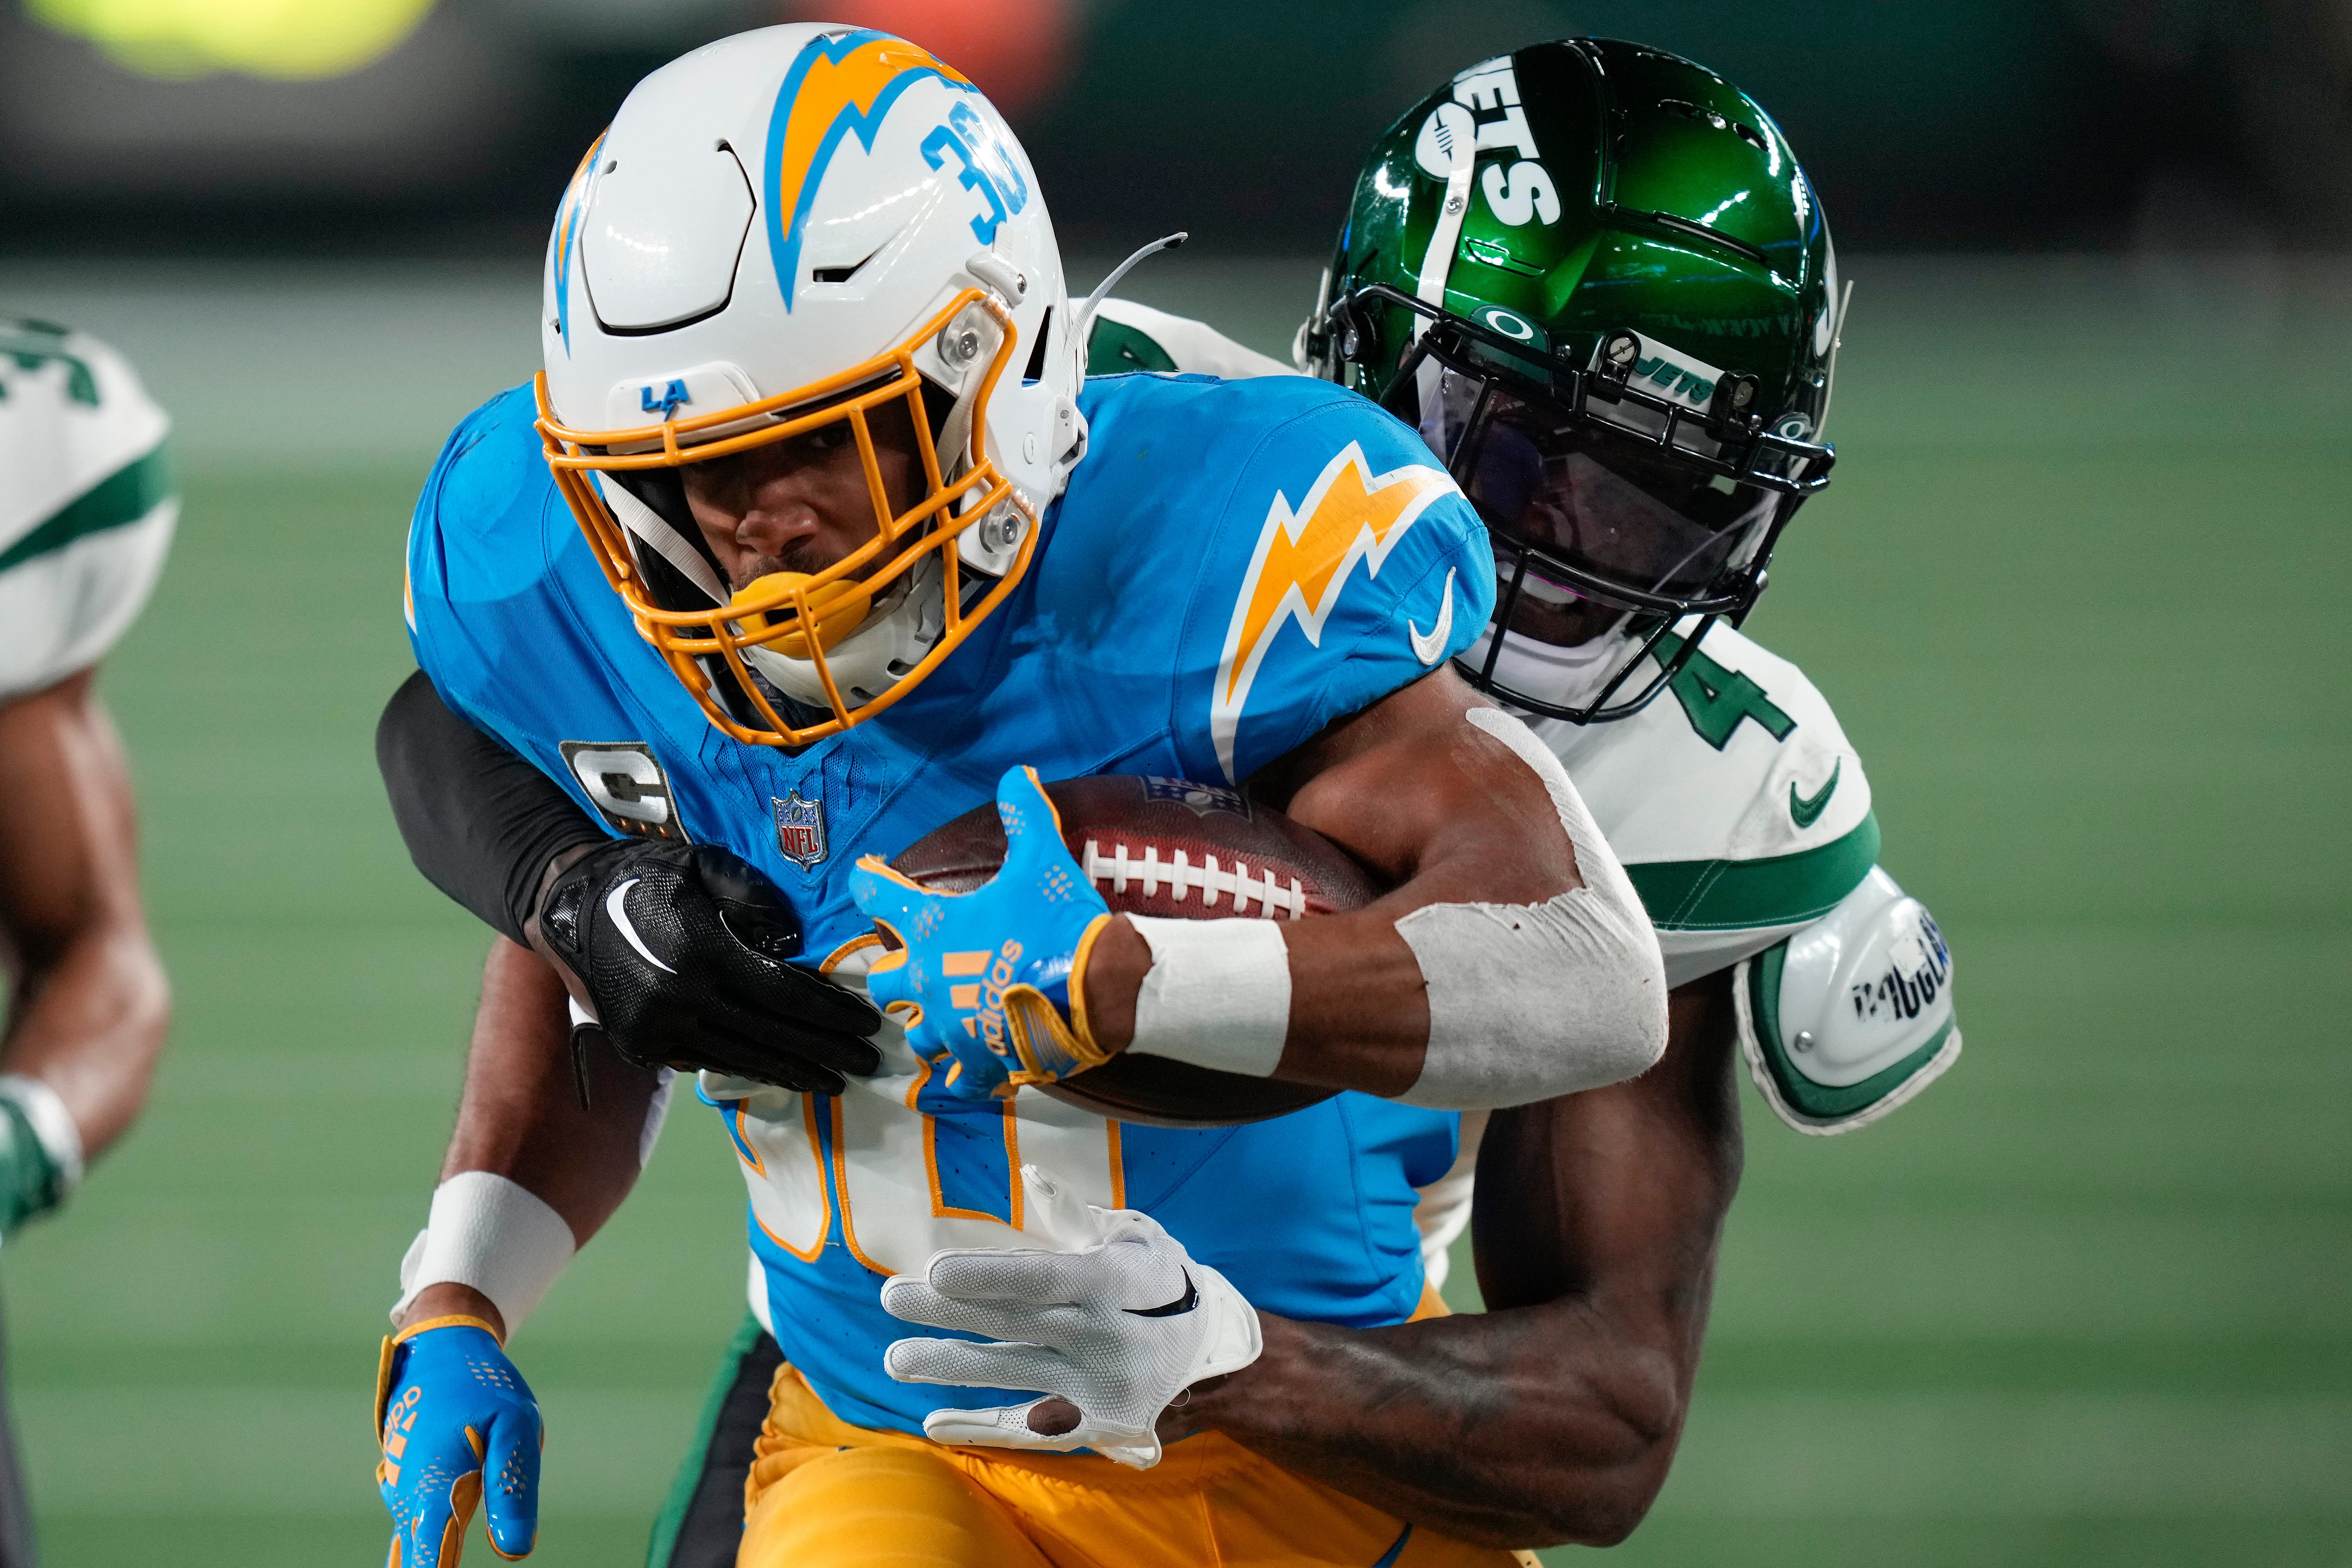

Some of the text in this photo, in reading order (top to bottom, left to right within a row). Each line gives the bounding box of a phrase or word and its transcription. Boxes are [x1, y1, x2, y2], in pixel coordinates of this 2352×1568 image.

[640, 379, 689, 422] LA
[1636, 356, 1716, 404] JETS
[1644, 630, 1798, 751] 4
[574, 750, 668, 824] C
[781, 826, 818, 856] NFL
[977, 938, 1023, 1056] adidas
